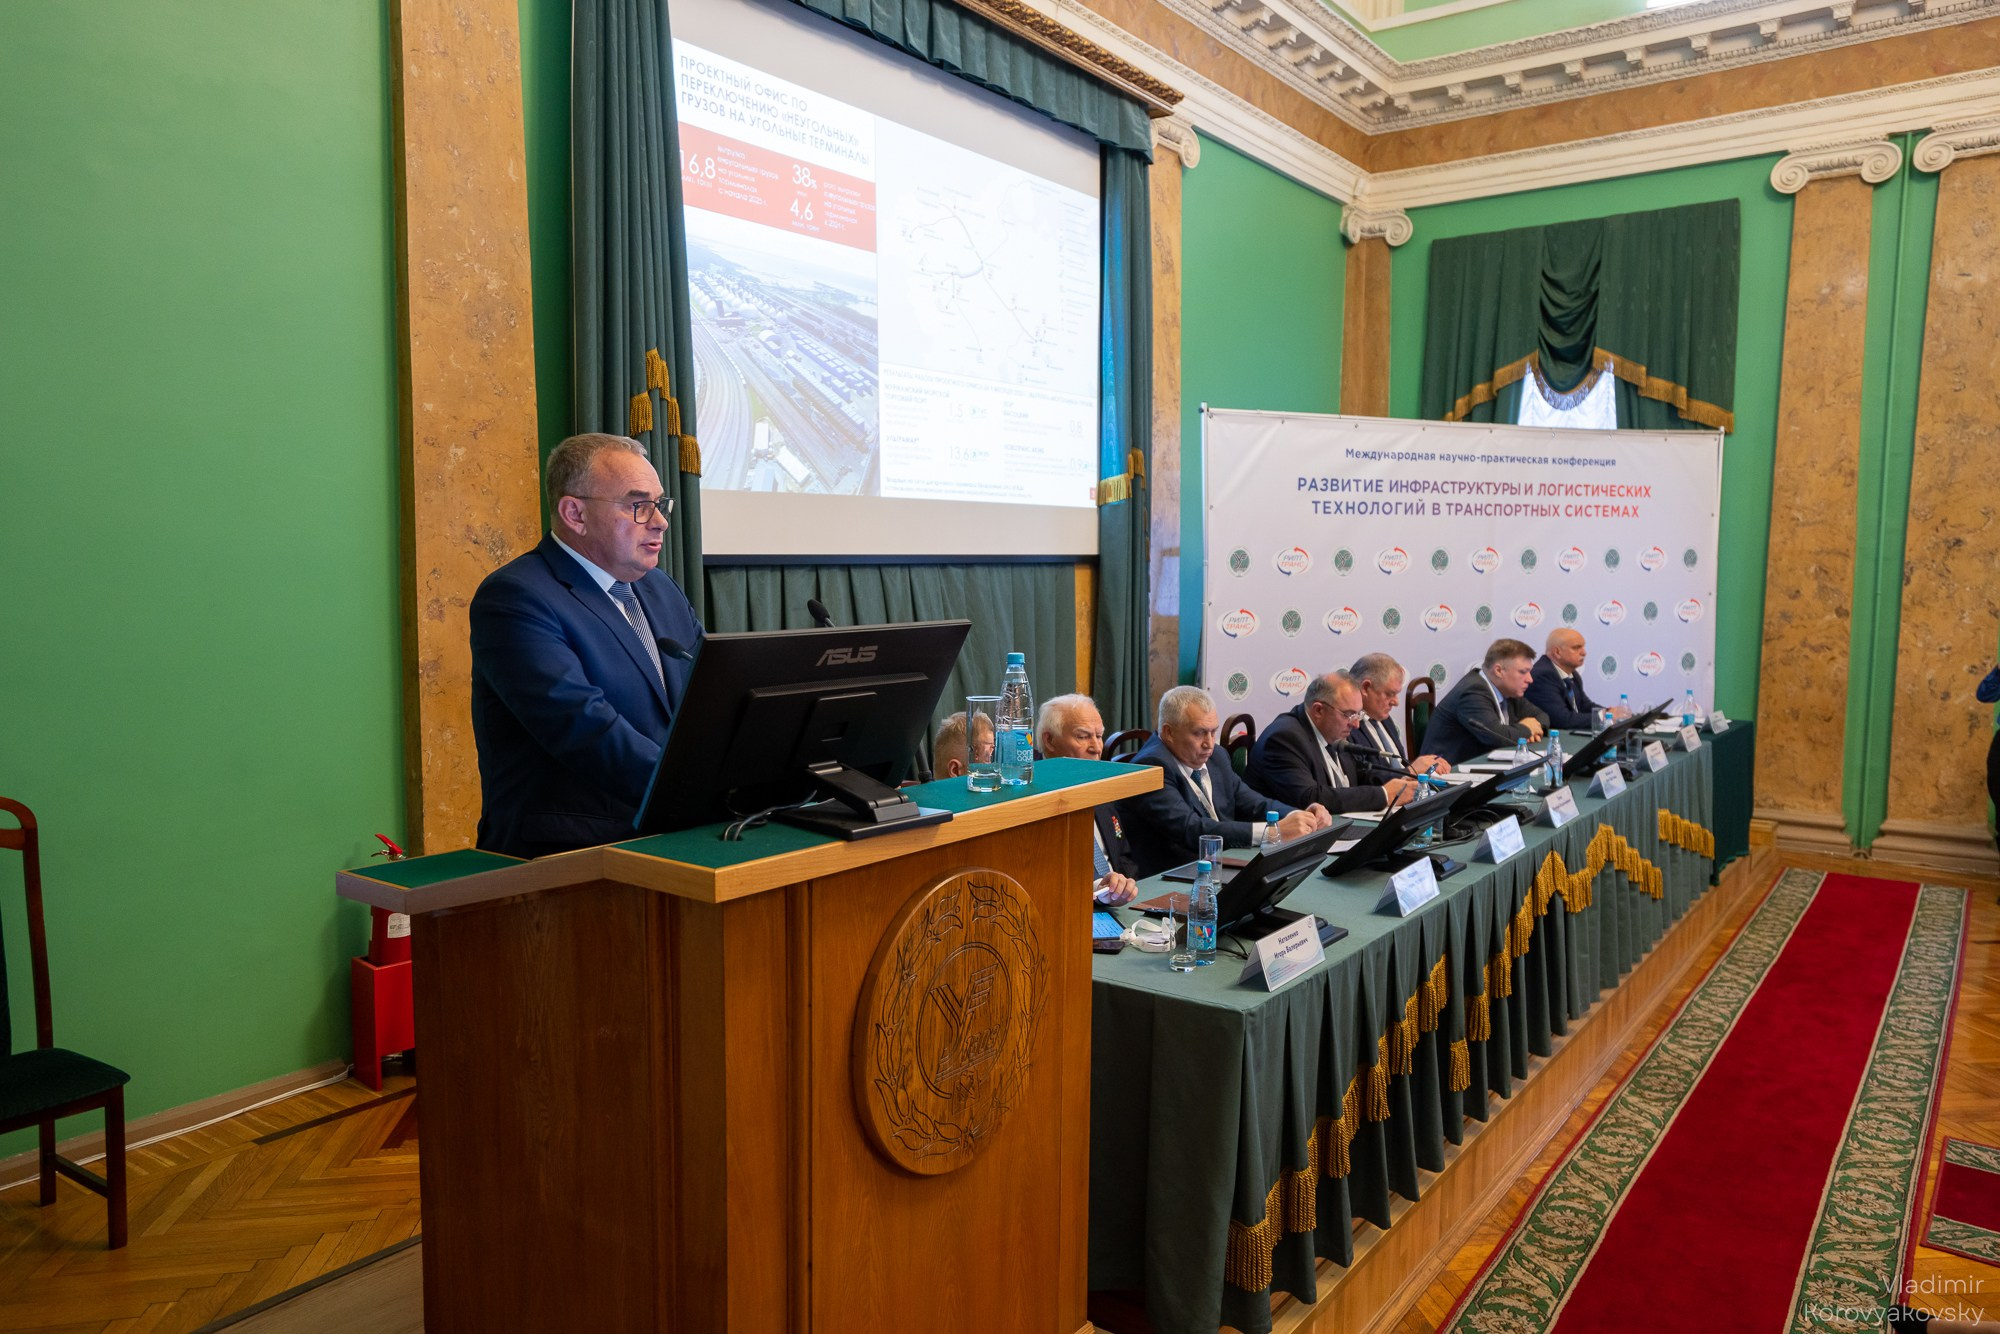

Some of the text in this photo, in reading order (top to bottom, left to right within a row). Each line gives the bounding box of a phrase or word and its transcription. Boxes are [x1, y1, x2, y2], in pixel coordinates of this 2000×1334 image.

[680, 55, 807, 112] ПРОЕКТНЫЙ ОФИС ПО
[681, 73, 779, 118] ПЕРЕКЛЮЧЕНИЮ
[681, 91, 870, 165] ГРУЗОВ НА УГОЛЬНЫЕ ТЕРМИНАЛЫ
[792, 164, 817, 190] 38%
[789, 197, 814, 221] 4,6
[1345, 448, 1617, 468] Международная научно-практическая конференция
[1297, 477, 1652, 498] РАЗВИТИЕ ИНФРАСТРУКТУРЫ И ЛОГИСТИЧЕСКИХ
[1311, 499, 1640, 518] ТЕХНОЛОГИЙ В ТРАНСПОРТНЫХ СИСТЕМАХ
[815, 645, 879, 667] ASUS
